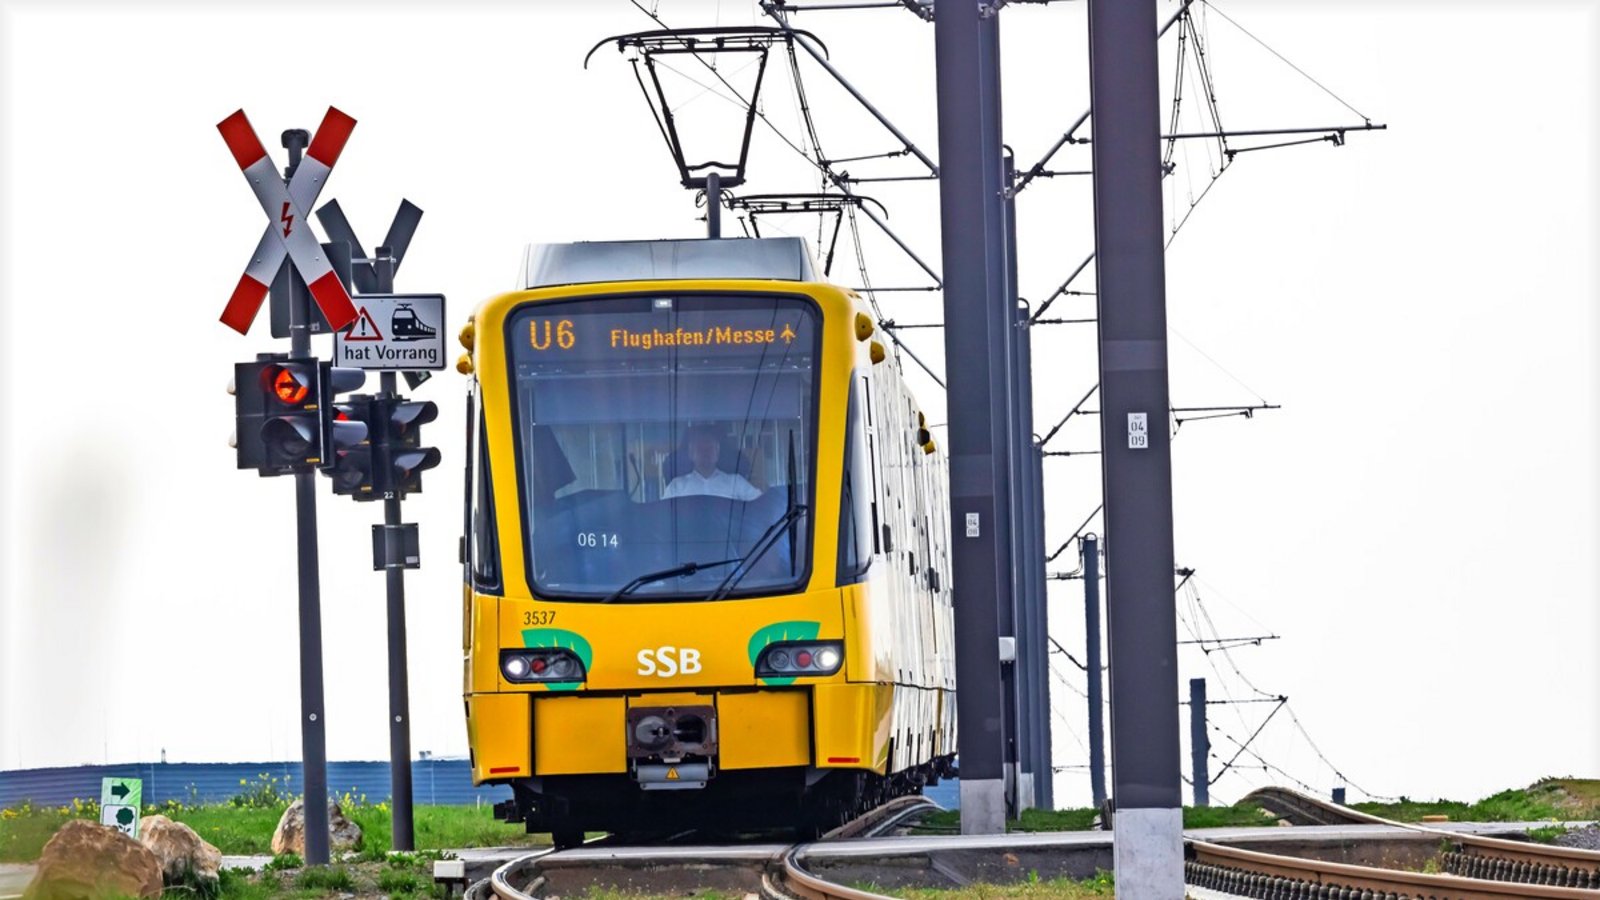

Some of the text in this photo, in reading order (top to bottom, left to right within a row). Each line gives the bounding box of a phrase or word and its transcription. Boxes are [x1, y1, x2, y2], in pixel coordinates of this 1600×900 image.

[529, 319, 775, 350] U6 Flughafen/Messe
[344, 344, 438, 364] hat Vorrang
[1131, 421, 1144, 431] 04
[1131, 435, 1145, 446] 09
[577, 532, 619, 548] 06 14
[523, 610, 556, 626] 3537
[637, 645, 703, 678] SSB
